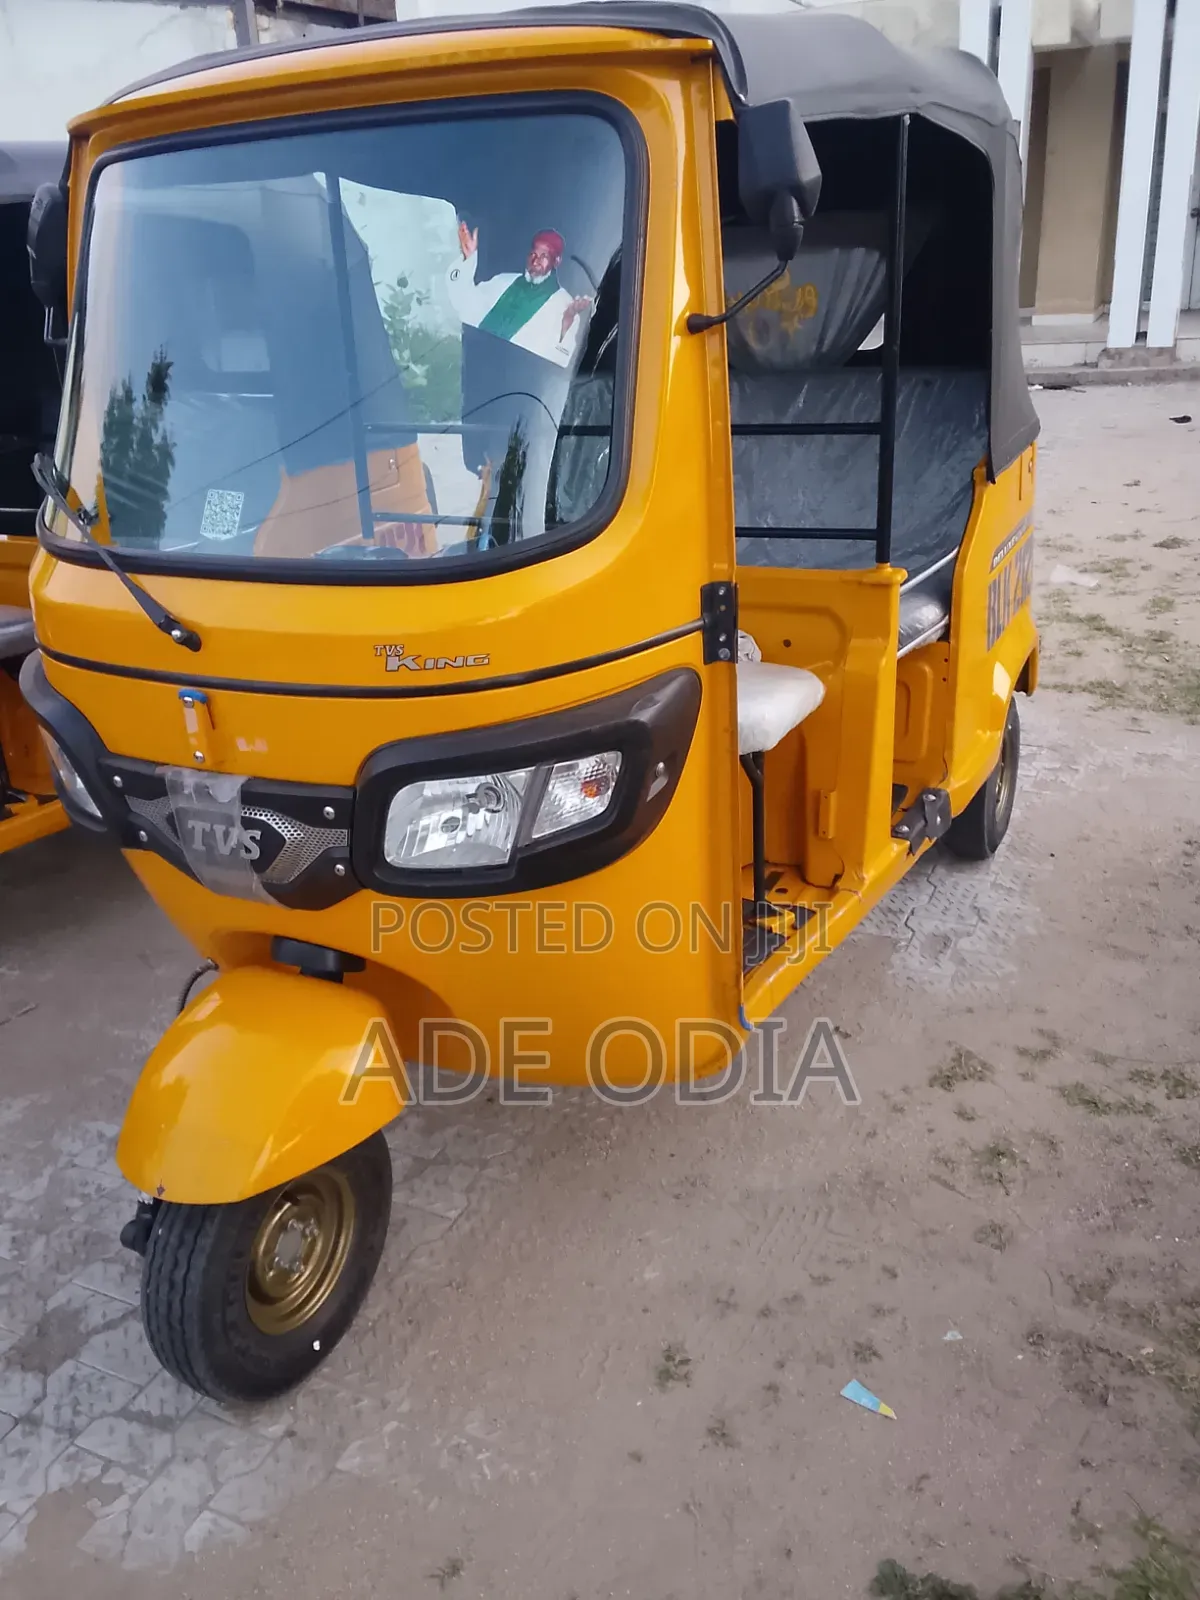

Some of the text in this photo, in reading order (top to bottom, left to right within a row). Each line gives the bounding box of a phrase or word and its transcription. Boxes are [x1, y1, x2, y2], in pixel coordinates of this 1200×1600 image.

[373, 644, 405, 656] TVS
[385, 653, 490, 672] KING
[188, 819, 262, 861] TVS
